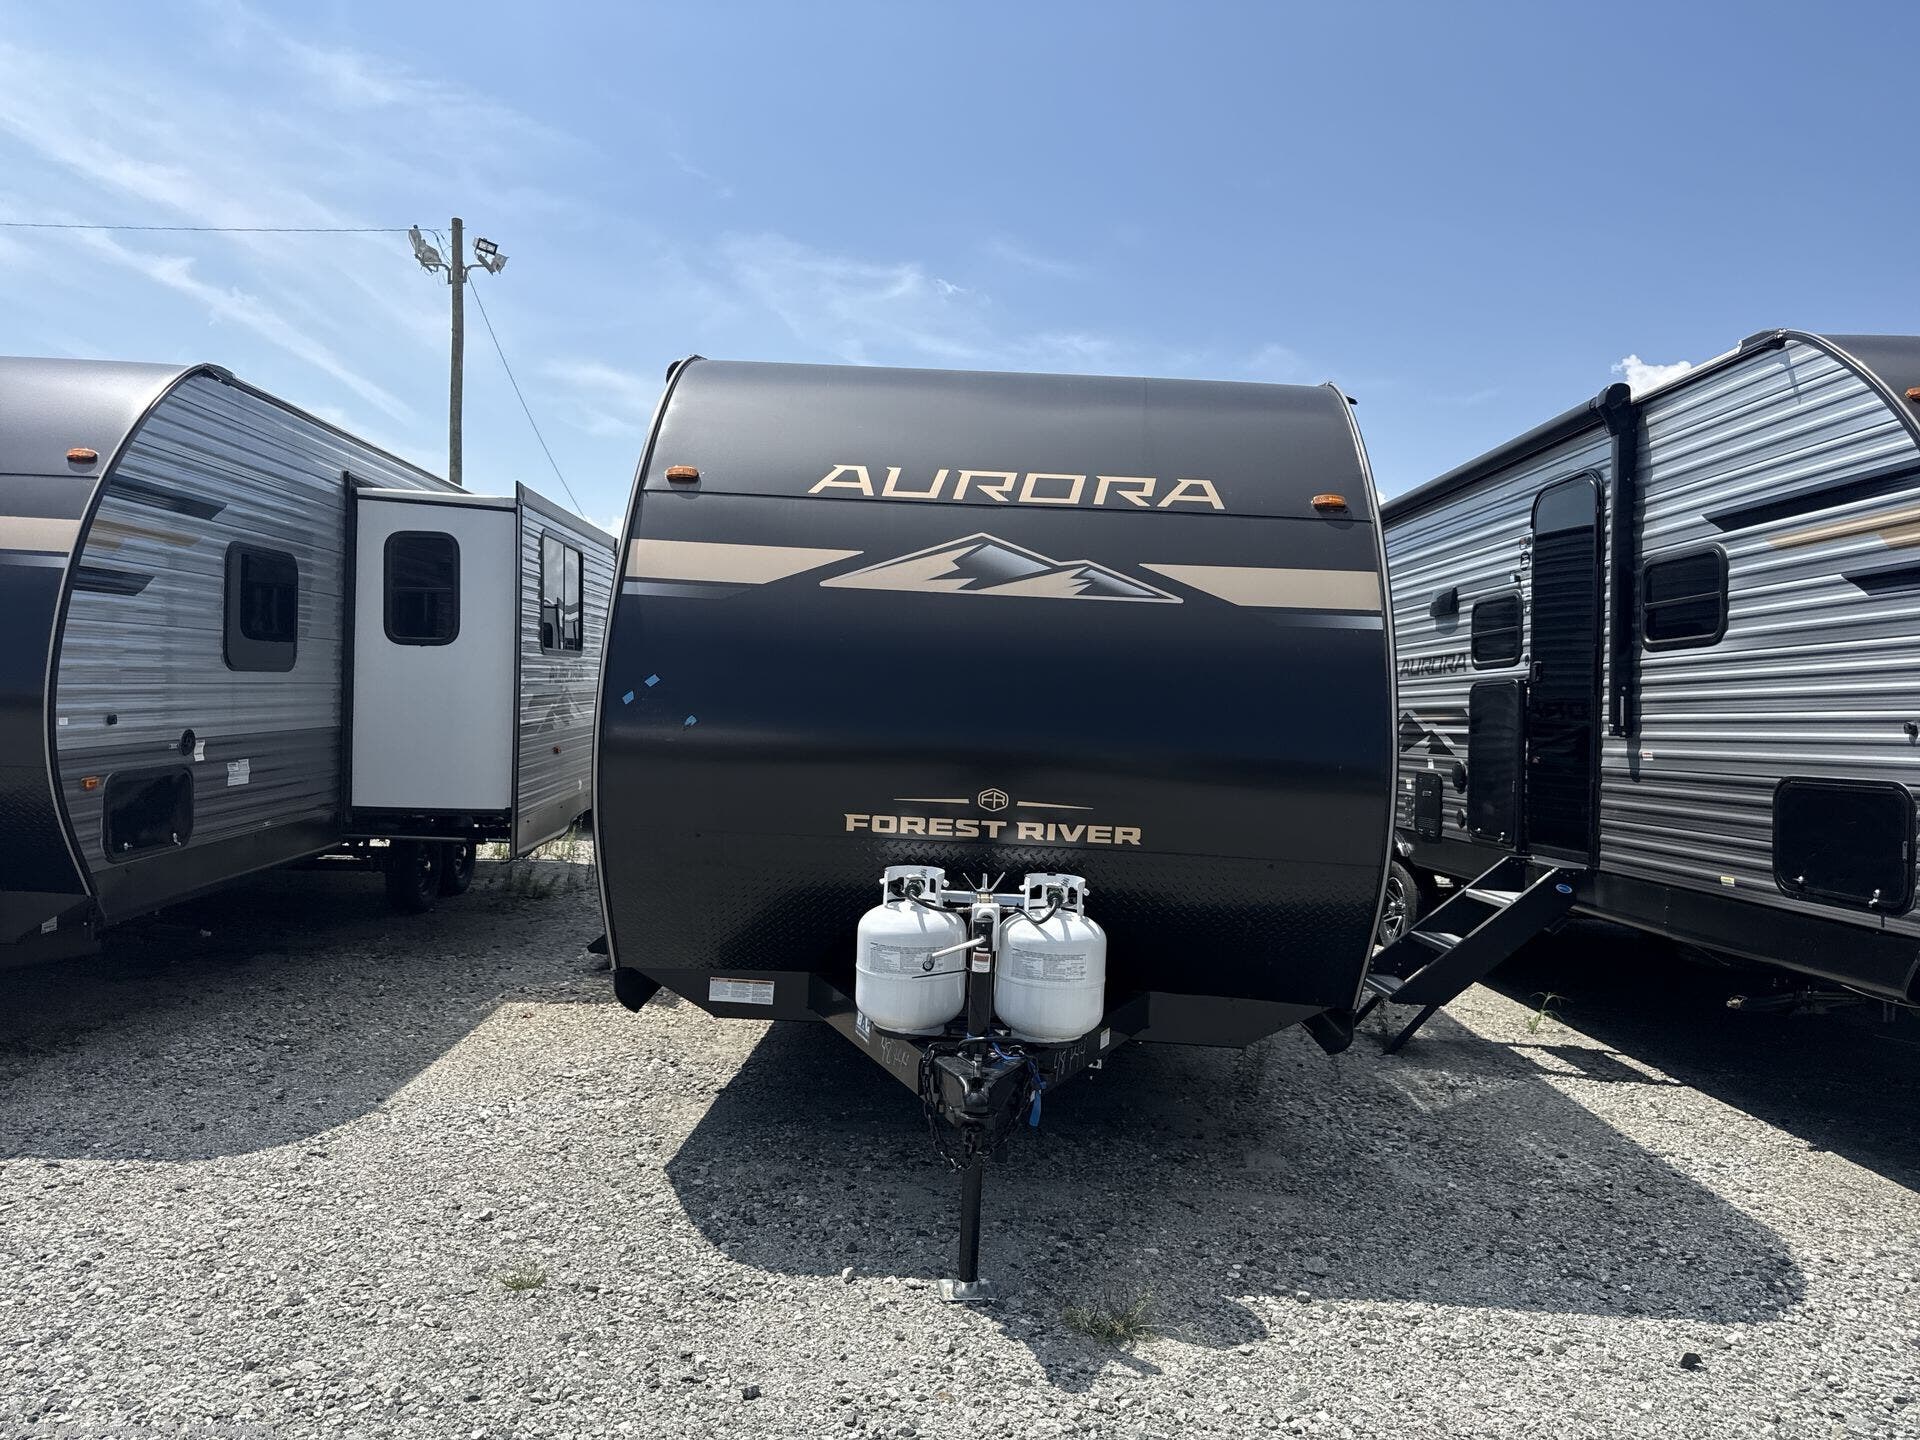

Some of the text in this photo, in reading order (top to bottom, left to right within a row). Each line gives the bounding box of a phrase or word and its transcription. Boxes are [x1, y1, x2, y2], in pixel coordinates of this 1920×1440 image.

[807, 464, 1225, 510] AURORA
[844, 813, 1142, 846] FOREST RIVER
